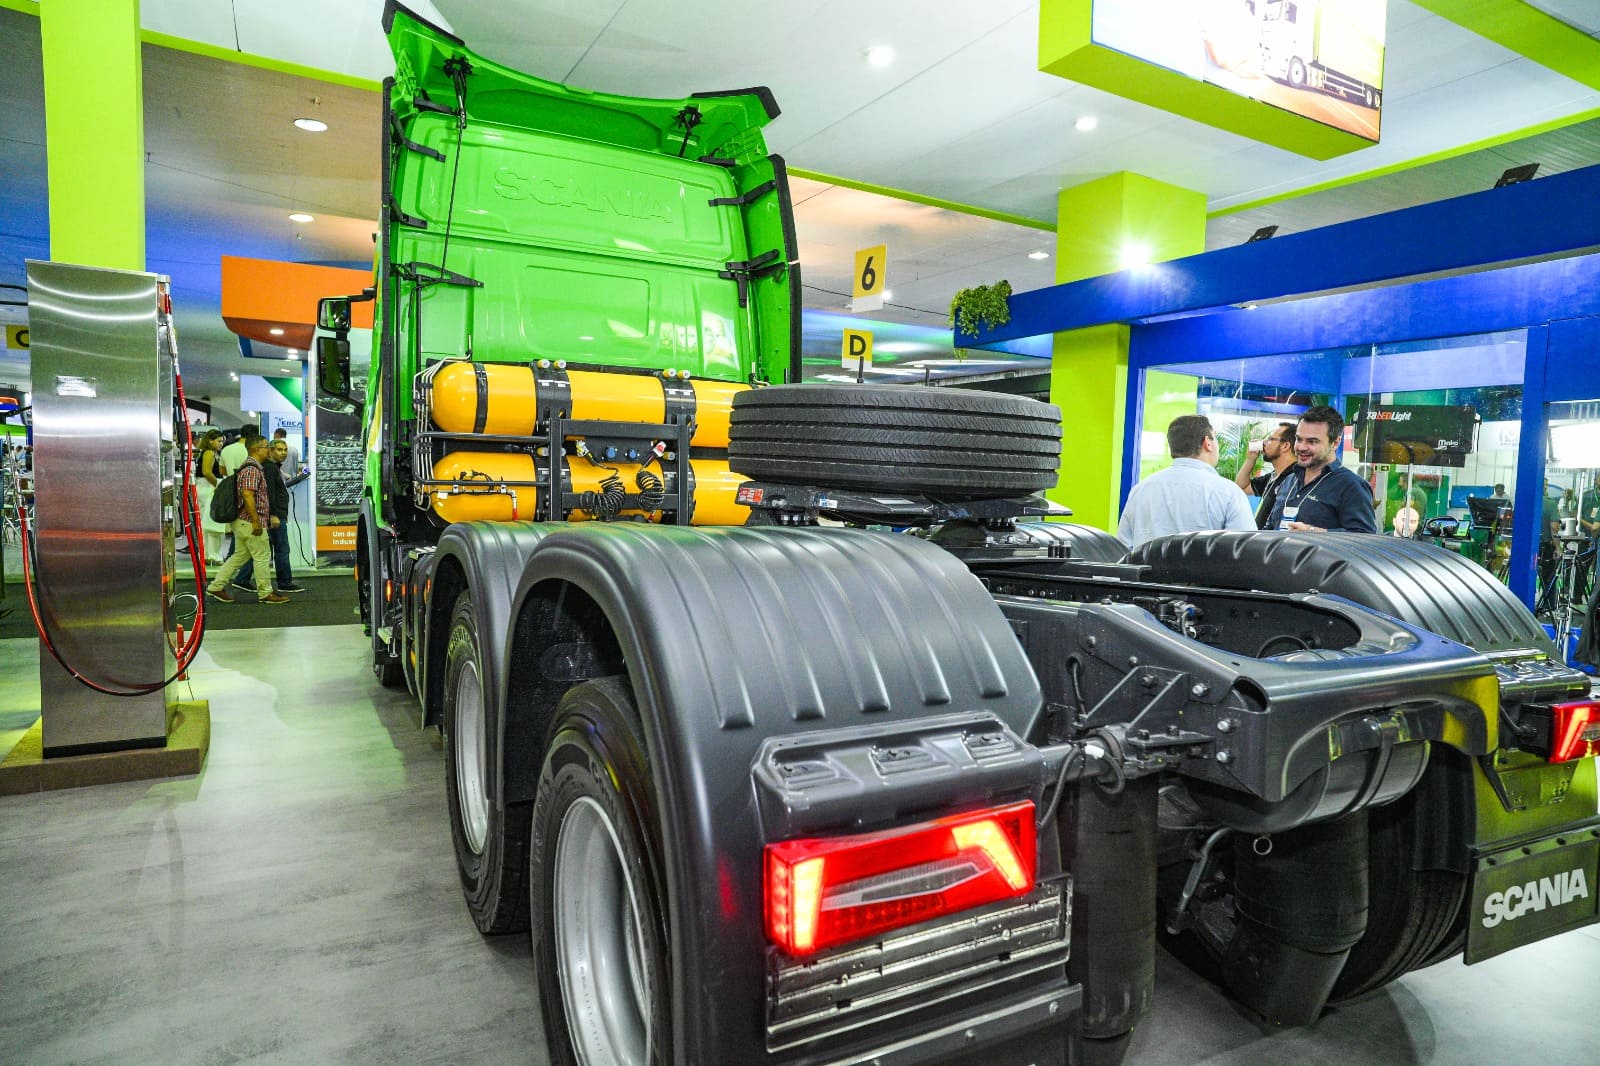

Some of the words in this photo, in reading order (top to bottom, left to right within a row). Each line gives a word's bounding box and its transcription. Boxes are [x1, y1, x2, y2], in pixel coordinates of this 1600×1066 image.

[493, 167, 673, 223] SCANIA
[861, 255, 876, 291] 6
[849, 334, 867, 356] D
[1481, 867, 1589, 929] SCANIA
